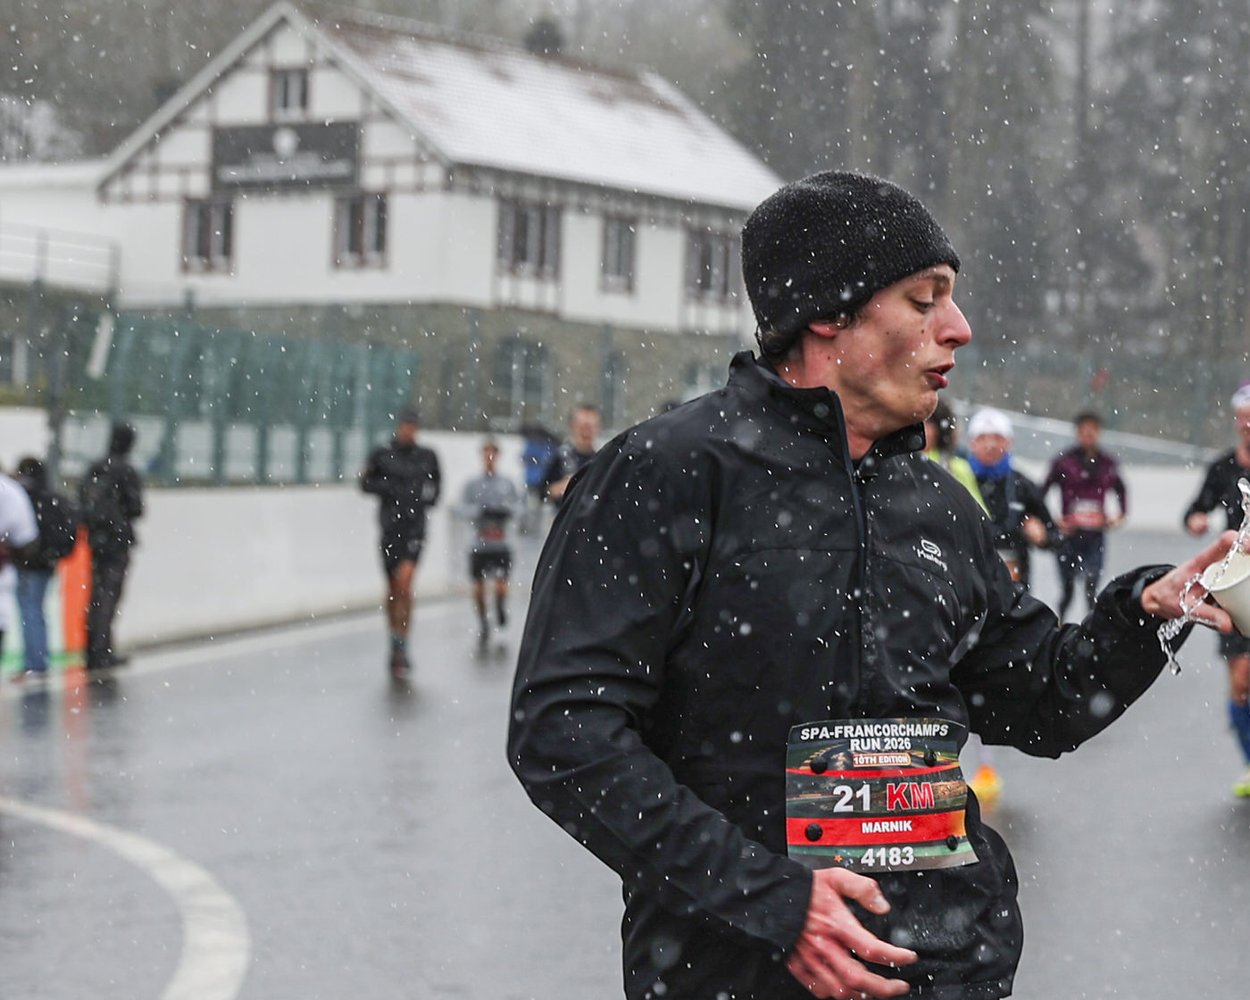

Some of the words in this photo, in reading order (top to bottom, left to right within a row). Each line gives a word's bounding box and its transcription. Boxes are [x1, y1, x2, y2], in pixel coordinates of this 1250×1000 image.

[801, 724, 948, 740] SPA-FRANCORCHAMPS
[850, 738, 881, 752] RUN
[884, 737, 911, 750] 2026
[853, 755, 877, 765] 10TH
[878, 754, 909, 764] EDITION
[832, 784, 871, 813] 21
[886, 782, 935, 811] KM
[861, 820, 912, 834] MARNIK
[860, 846, 914, 867] 4183
